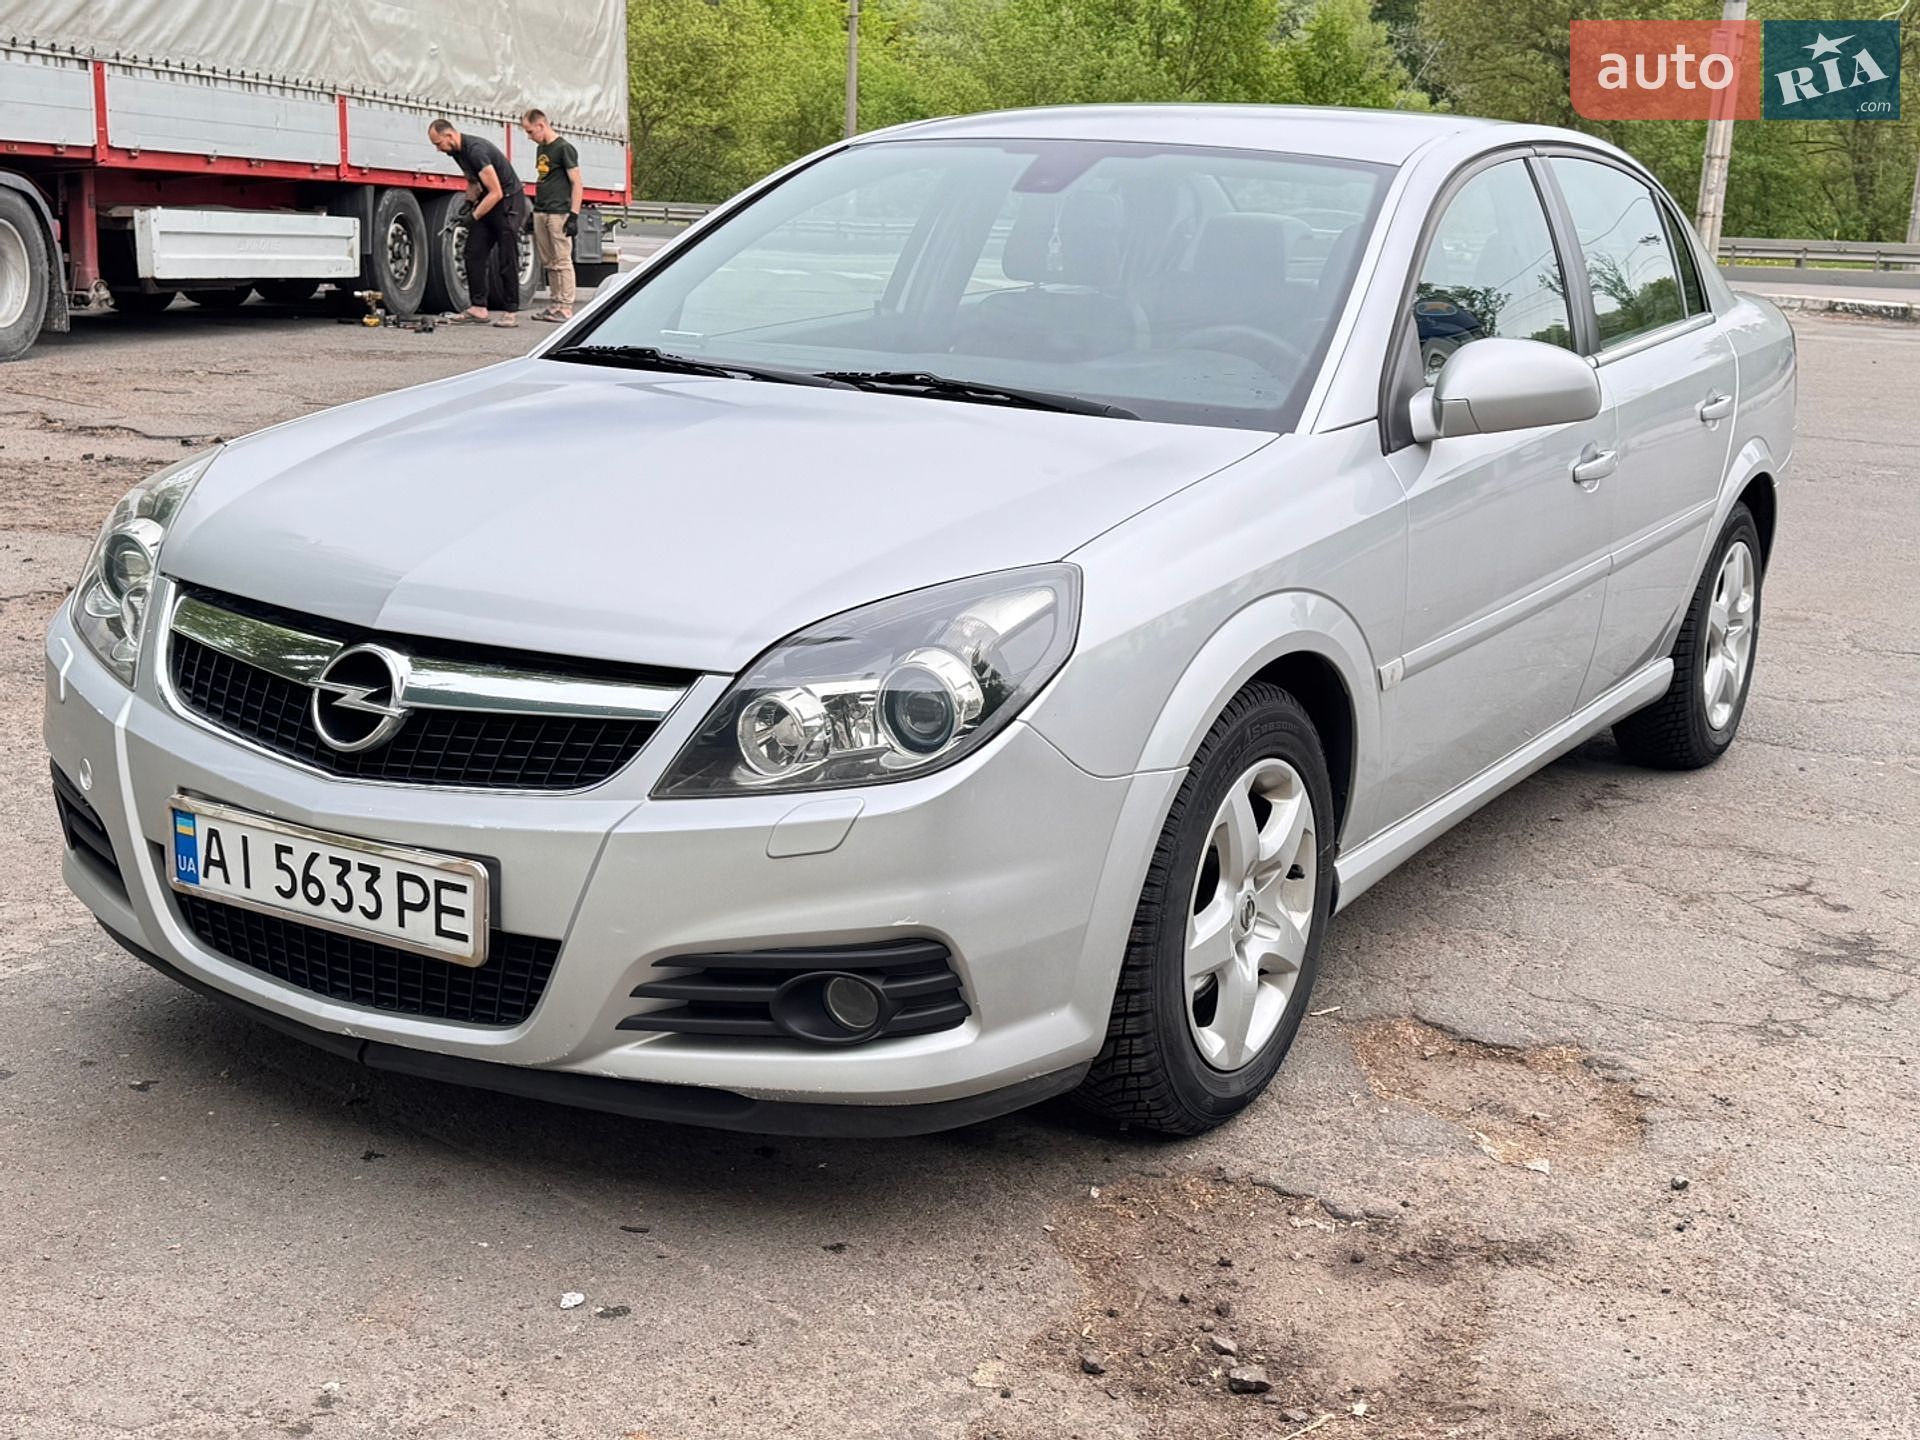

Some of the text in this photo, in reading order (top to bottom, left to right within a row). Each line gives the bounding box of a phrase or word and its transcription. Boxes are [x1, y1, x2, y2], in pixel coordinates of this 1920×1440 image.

[177, 854, 197, 874] UA
[202, 828, 469, 943] AI 5633 PE
